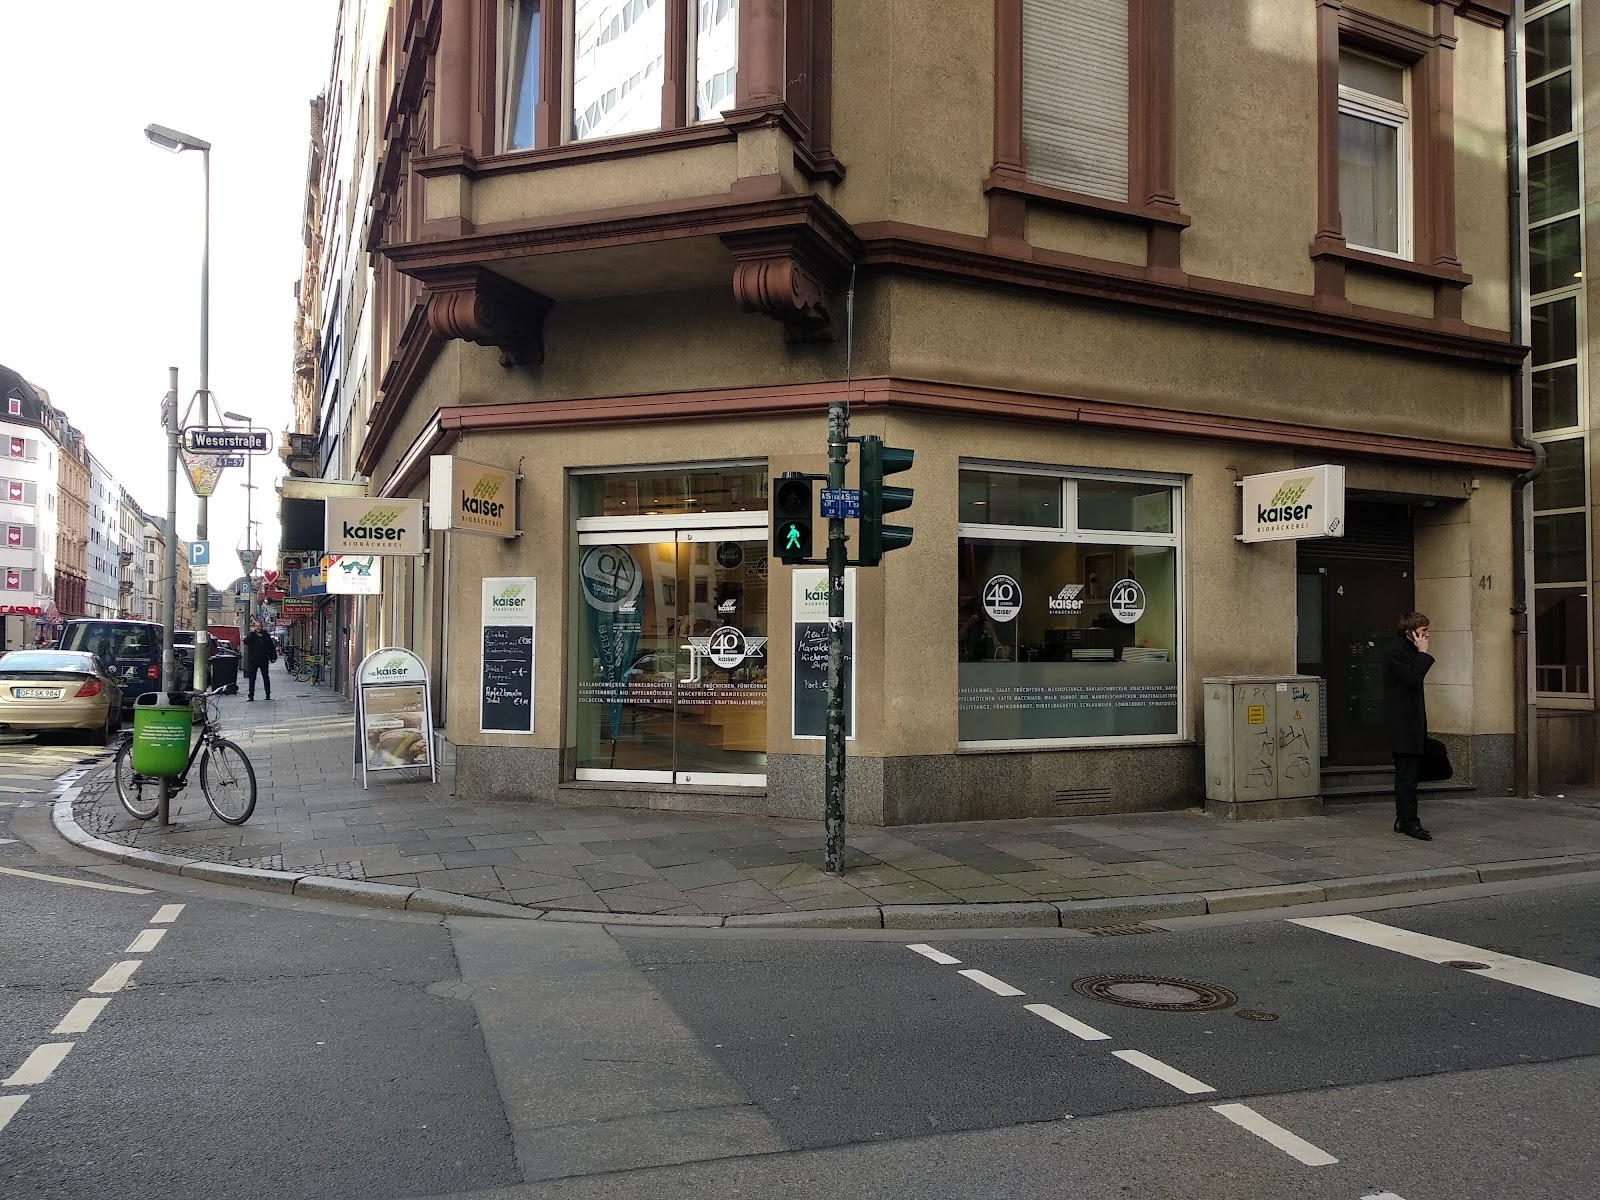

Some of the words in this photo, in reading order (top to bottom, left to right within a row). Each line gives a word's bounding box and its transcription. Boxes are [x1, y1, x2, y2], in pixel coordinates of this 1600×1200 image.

[195, 434, 262, 448] Weserstraße
[461, 489, 505, 519] kaiser
[461, 515, 502, 527] BIOBÄCKEREI
[1257, 503, 1313, 524] kaiser
[343, 521, 406, 541] kaiser
[1257, 523, 1309, 533] BIOBÄCKEREI
[1478, 575, 1492, 590] 41
[805, 588, 830, 601] kais
[986, 584, 1013, 607] 40
[1113, 587, 1137, 609] 40
[1337, 585, 1344, 596] 4
[492, 595, 526, 607] kaiser
[1048, 595, 1084, 610] kaiser
[711, 634, 738, 655] 40
[376, 667, 409, 676] kaiser
